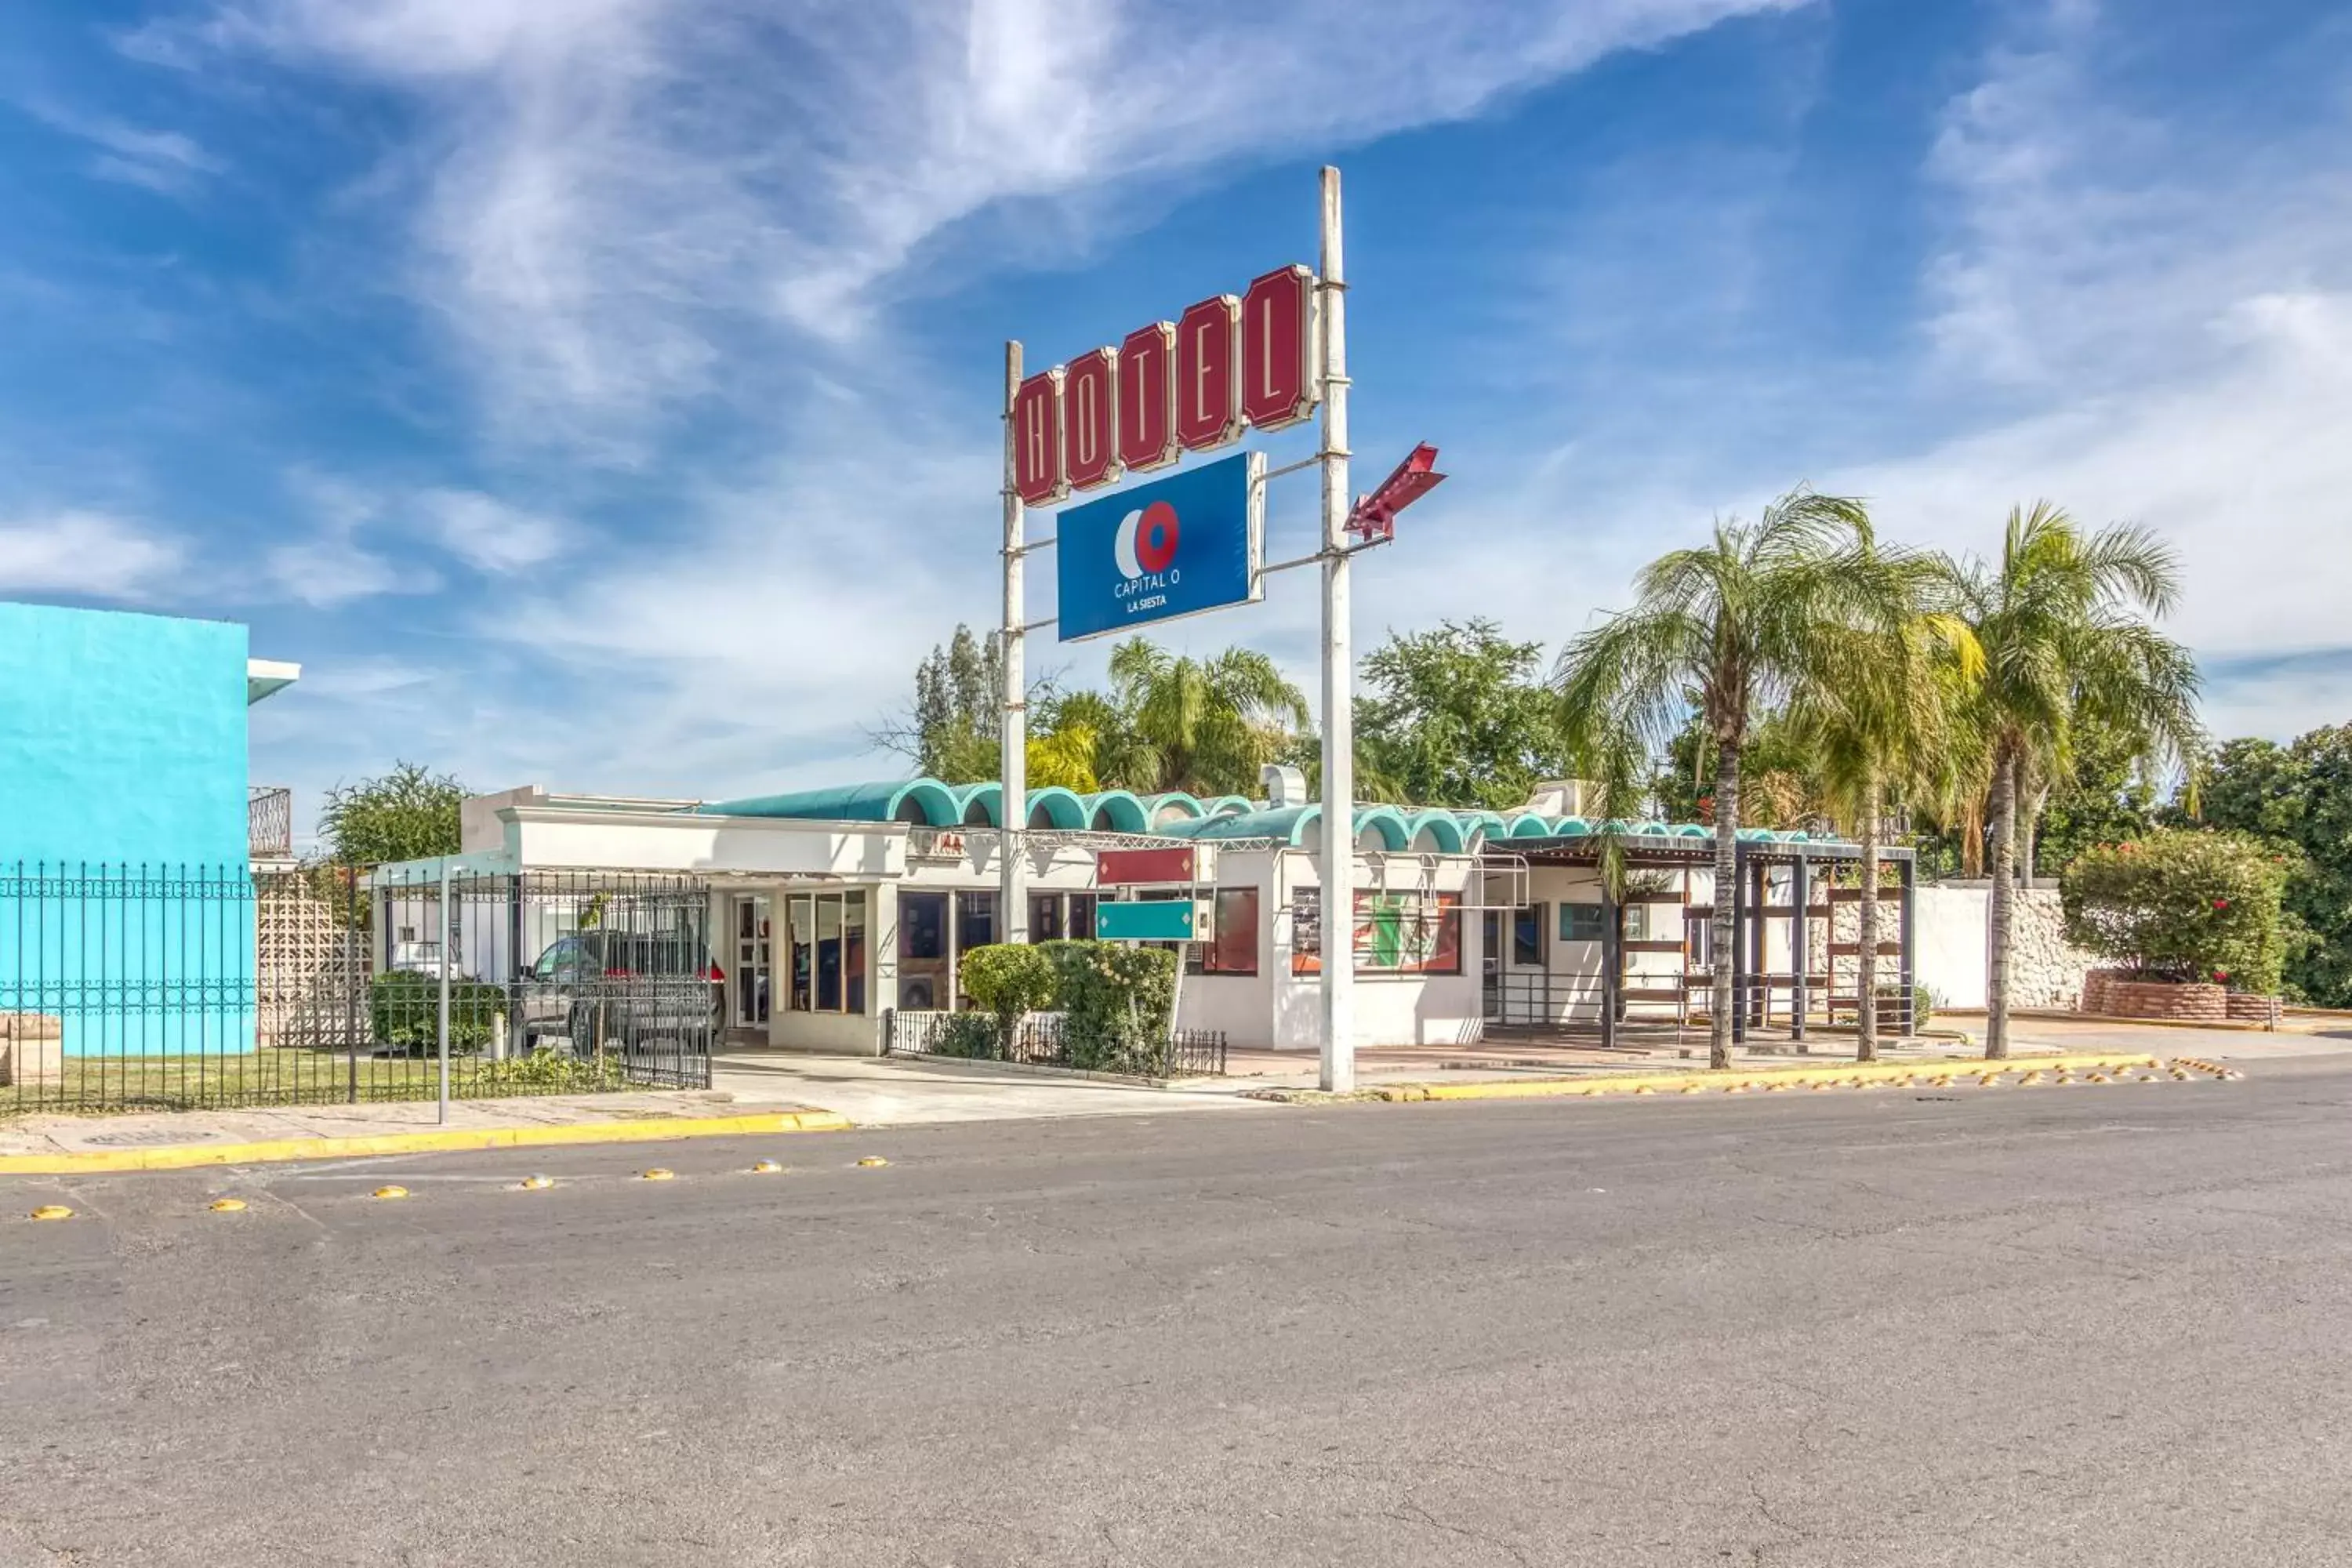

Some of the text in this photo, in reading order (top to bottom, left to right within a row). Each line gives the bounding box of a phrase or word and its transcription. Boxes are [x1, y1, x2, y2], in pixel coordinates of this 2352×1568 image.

[1026, 297, 1281, 483] HOTEL
[1115, 569, 1180, 598] CAPITAL O
[1127, 595, 1167, 612] LA SIESTA
